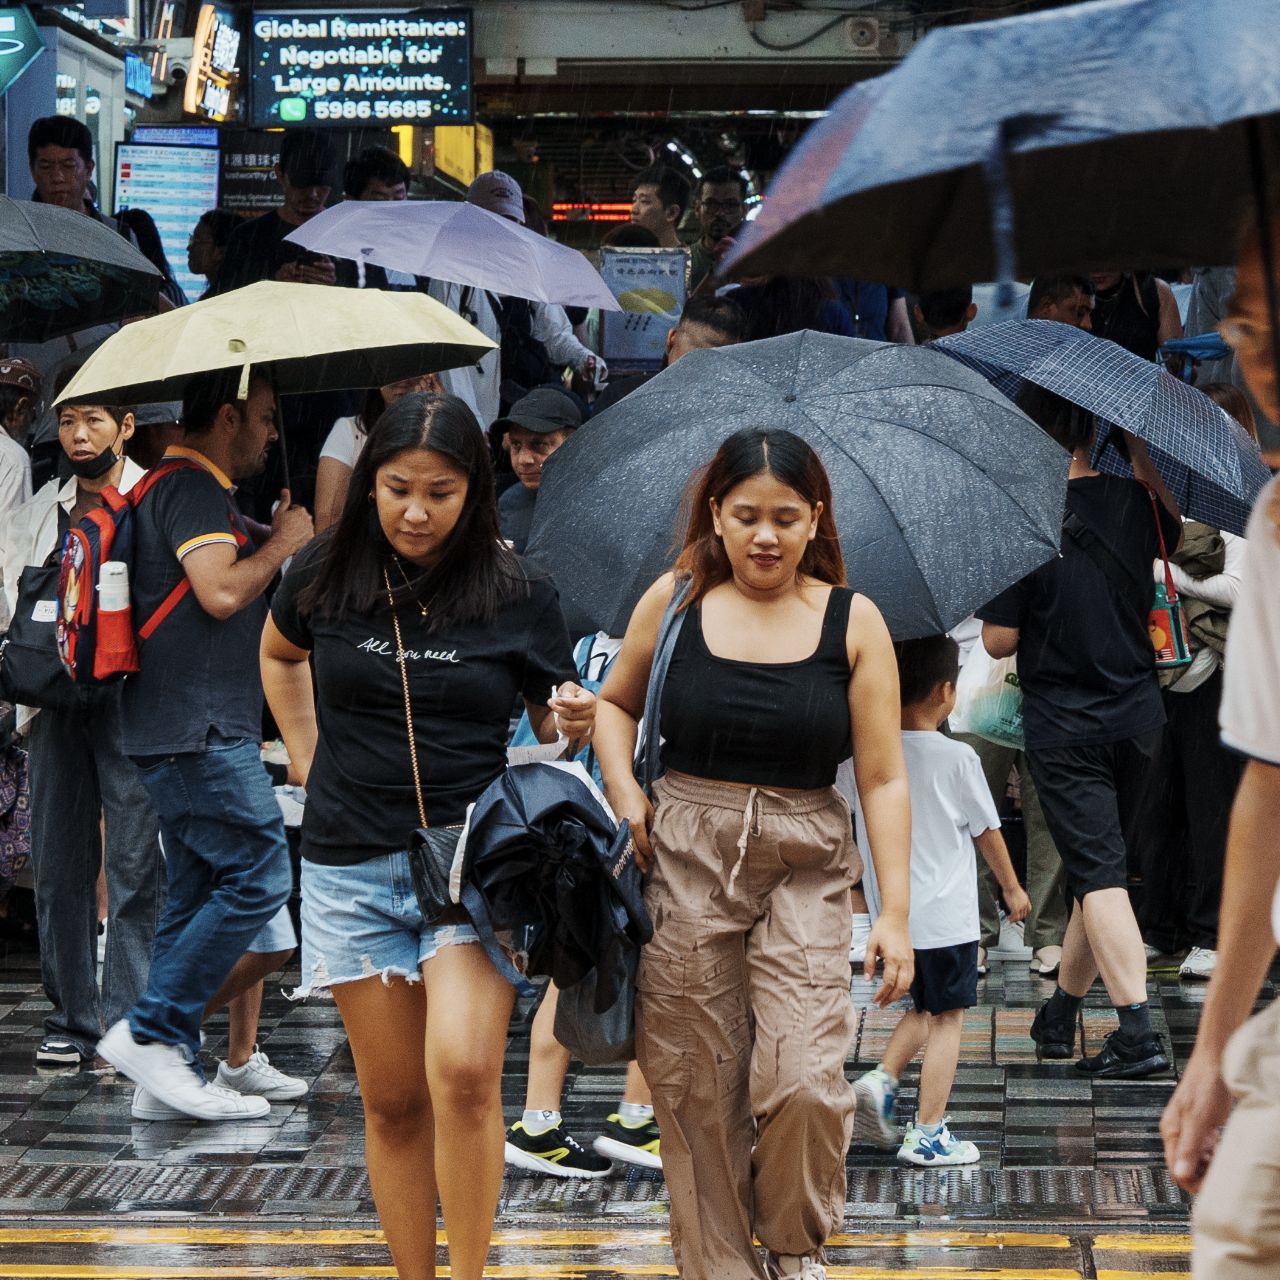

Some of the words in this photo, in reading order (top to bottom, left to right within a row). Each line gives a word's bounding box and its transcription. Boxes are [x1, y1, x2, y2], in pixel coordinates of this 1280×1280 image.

[254, 18, 327, 38] Global
[330, 18, 466, 38] Remittance:
[279, 46, 403, 70] Negotiable
[405, 45, 443, 65] for
[274, 74, 341, 97] Large
[343, 73, 452, 92] Amounts.
[314, 100, 371, 119] 5986
[373, 100, 432, 119] 5685
[357, 637, 393, 656] All
[395, 649, 421, 663] you
[423, 649, 461, 663] need
